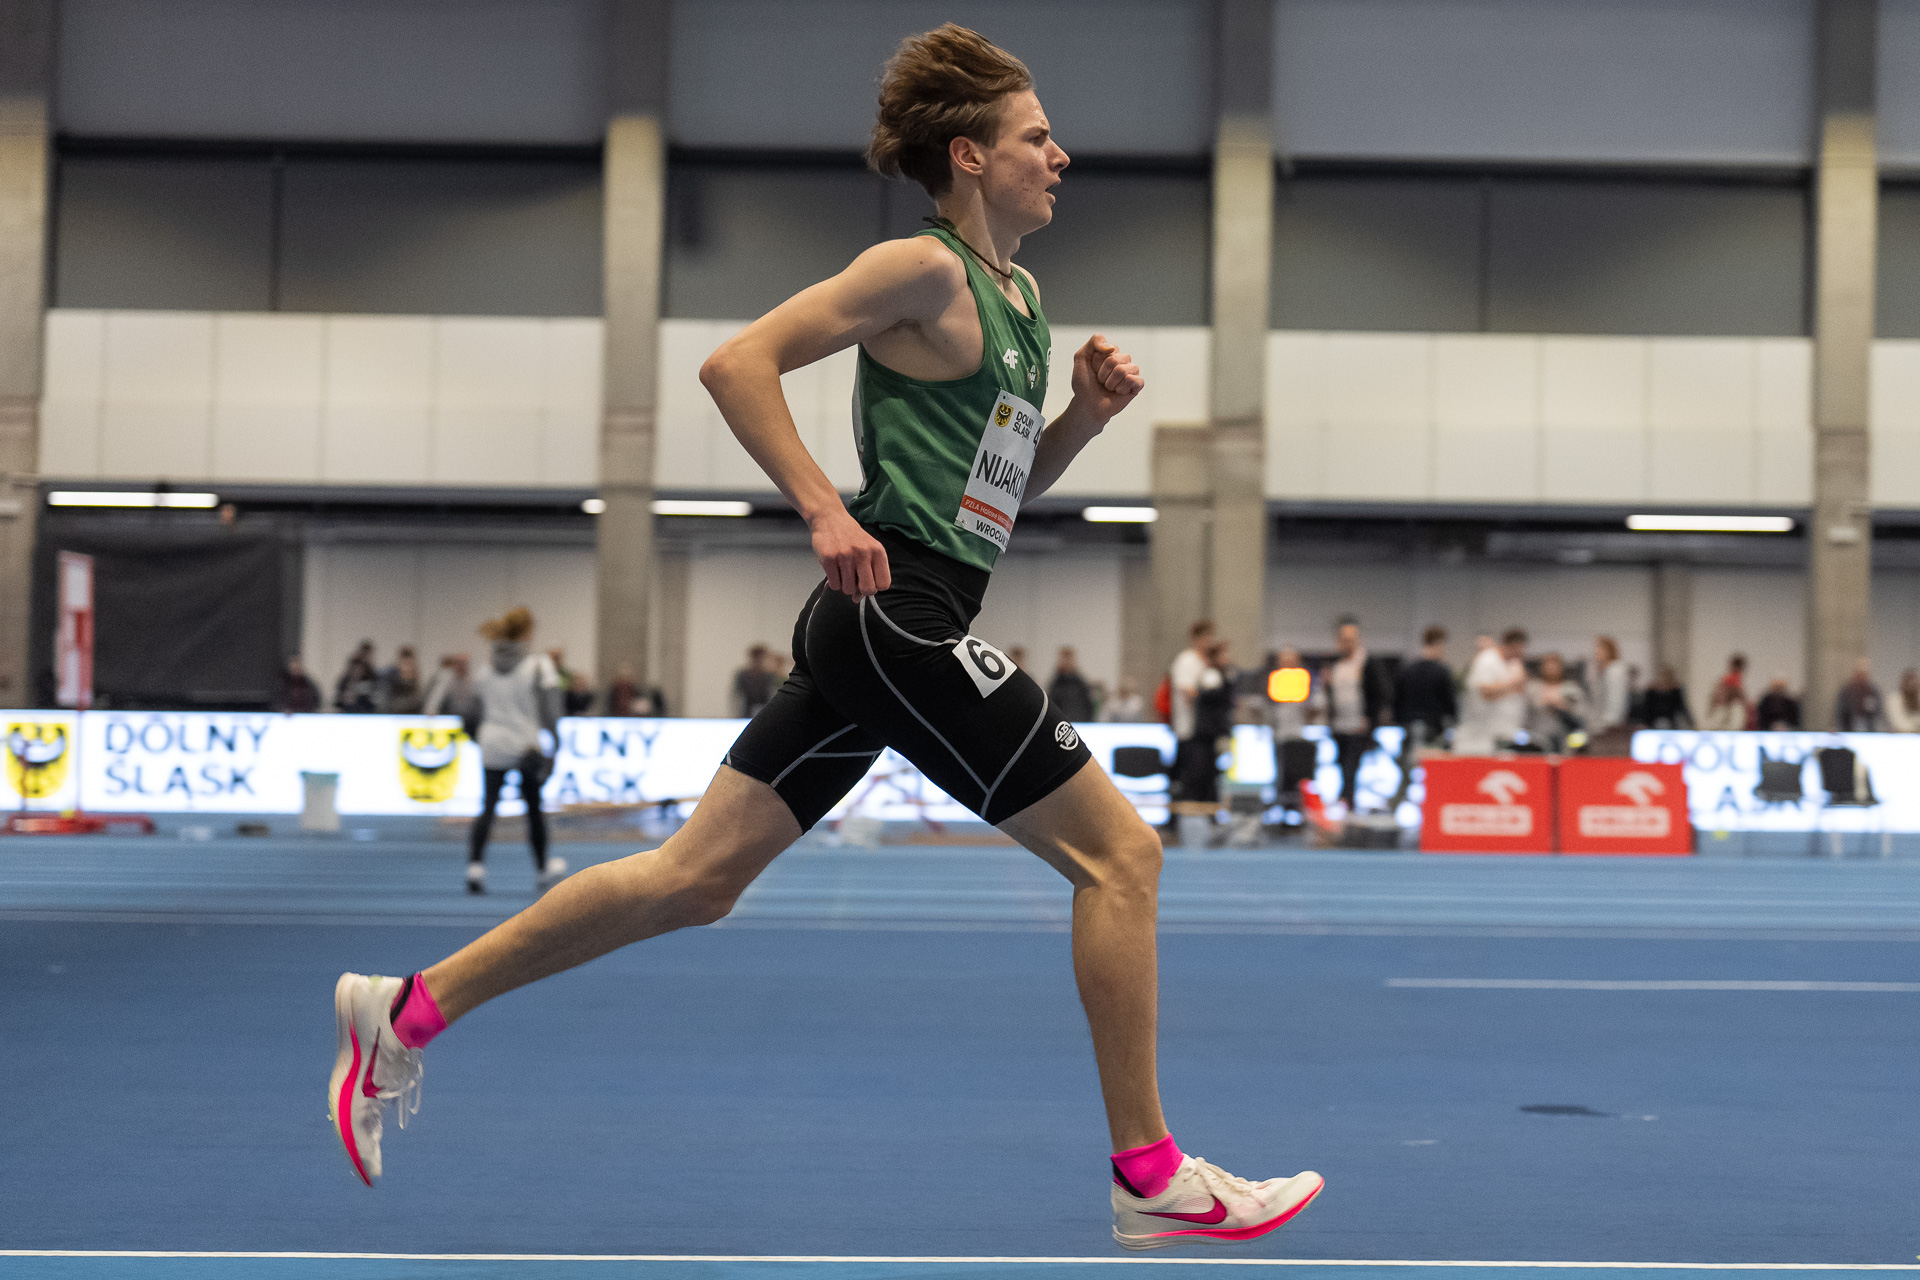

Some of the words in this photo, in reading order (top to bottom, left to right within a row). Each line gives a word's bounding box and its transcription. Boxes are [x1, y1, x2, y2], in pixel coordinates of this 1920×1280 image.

[1003, 348, 1018, 369] 4F
[966, 639, 1006, 681] 6
[106, 724, 269, 753] DOLNY
[105, 758, 257, 802] ŚLĄSK
